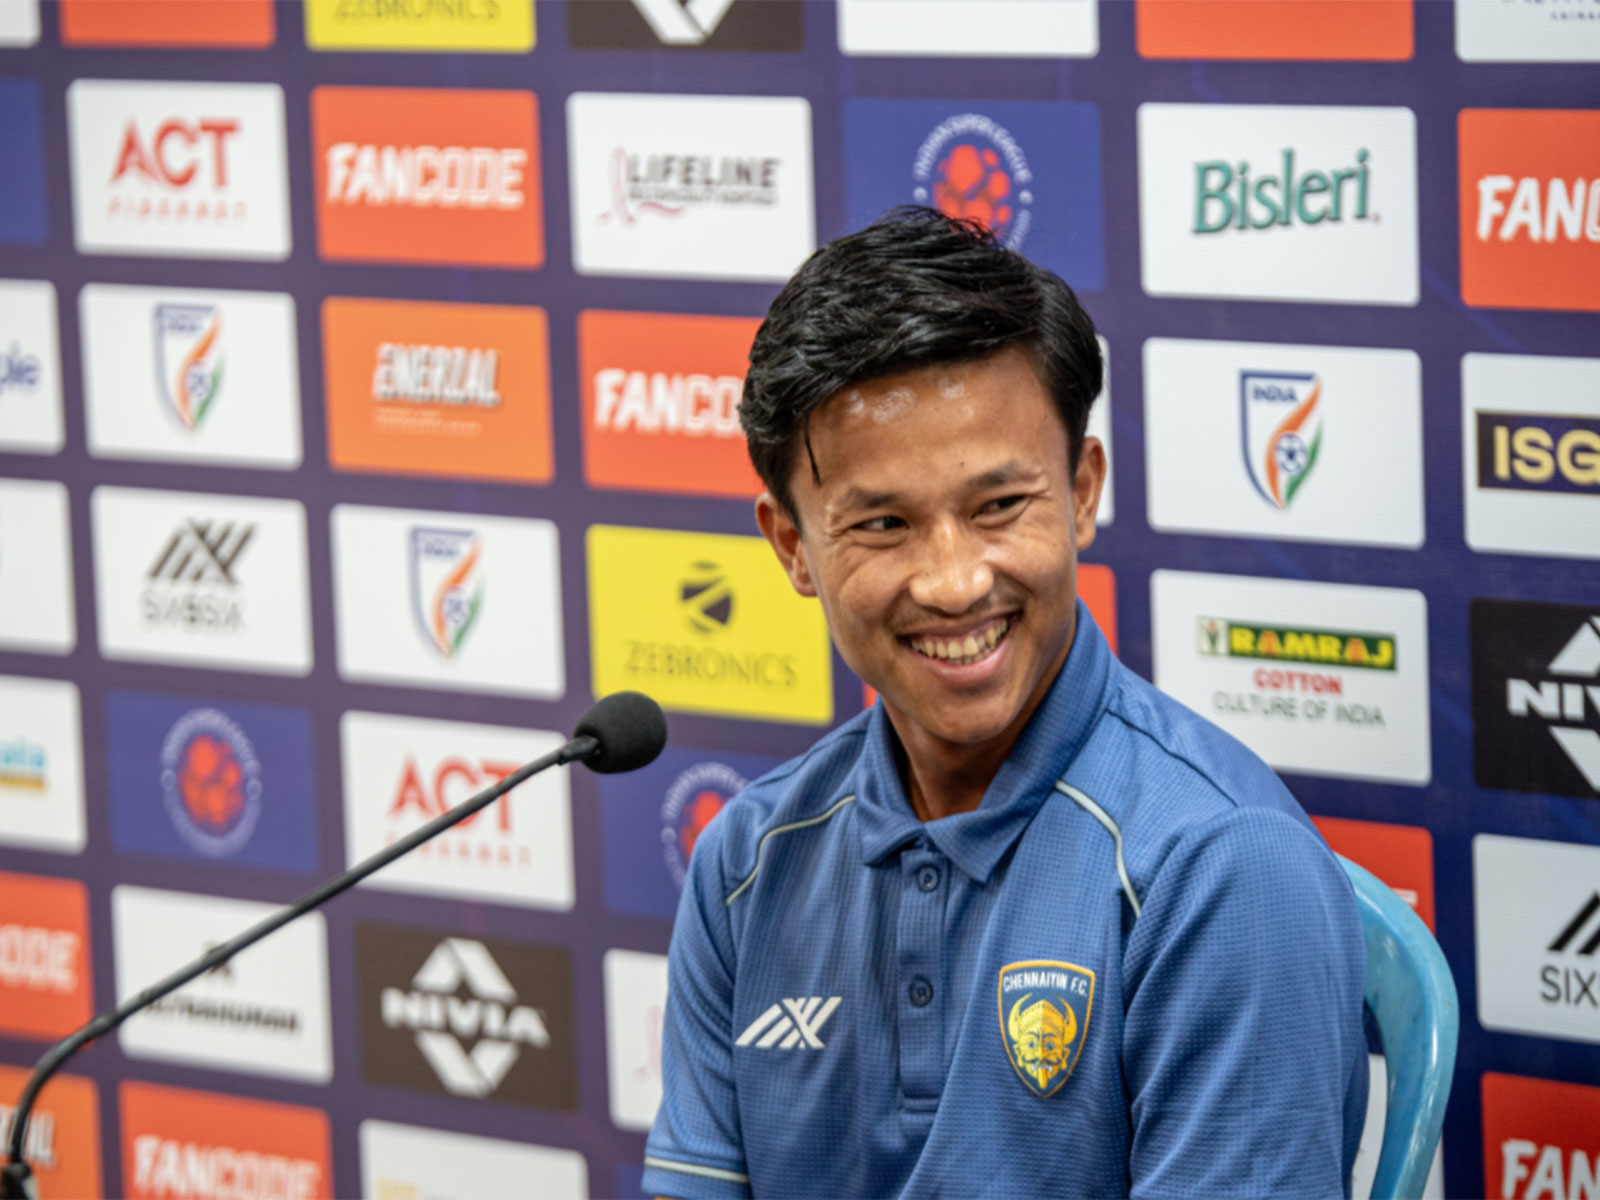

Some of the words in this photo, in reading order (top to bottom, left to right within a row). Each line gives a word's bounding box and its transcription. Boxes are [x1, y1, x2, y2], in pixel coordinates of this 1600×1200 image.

[109, 116, 241, 189] ACT
[627, 153, 781, 188] LIFELINE
[327, 142, 527, 210] FANCODE
[1191, 147, 1370, 236] Bisleri
[1252, 384, 1299, 402] INDIA
[625, 638, 798, 690] ZEBRONICS
[1230, 626, 1395, 668] RAMRAJ
[1253, 668, 1343, 695] COTTON
[1506, 678, 1600, 722] NI
[1212, 690, 1297, 720] CULTURE
[1304, 698, 1328, 720] OF
[1335, 703, 1386, 727] INDIA
[386, 753, 526, 833] ACT
[1003, 971, 1068, 993] CHENNAIYIN
[380, 986, 550, 1048] NIVIA
